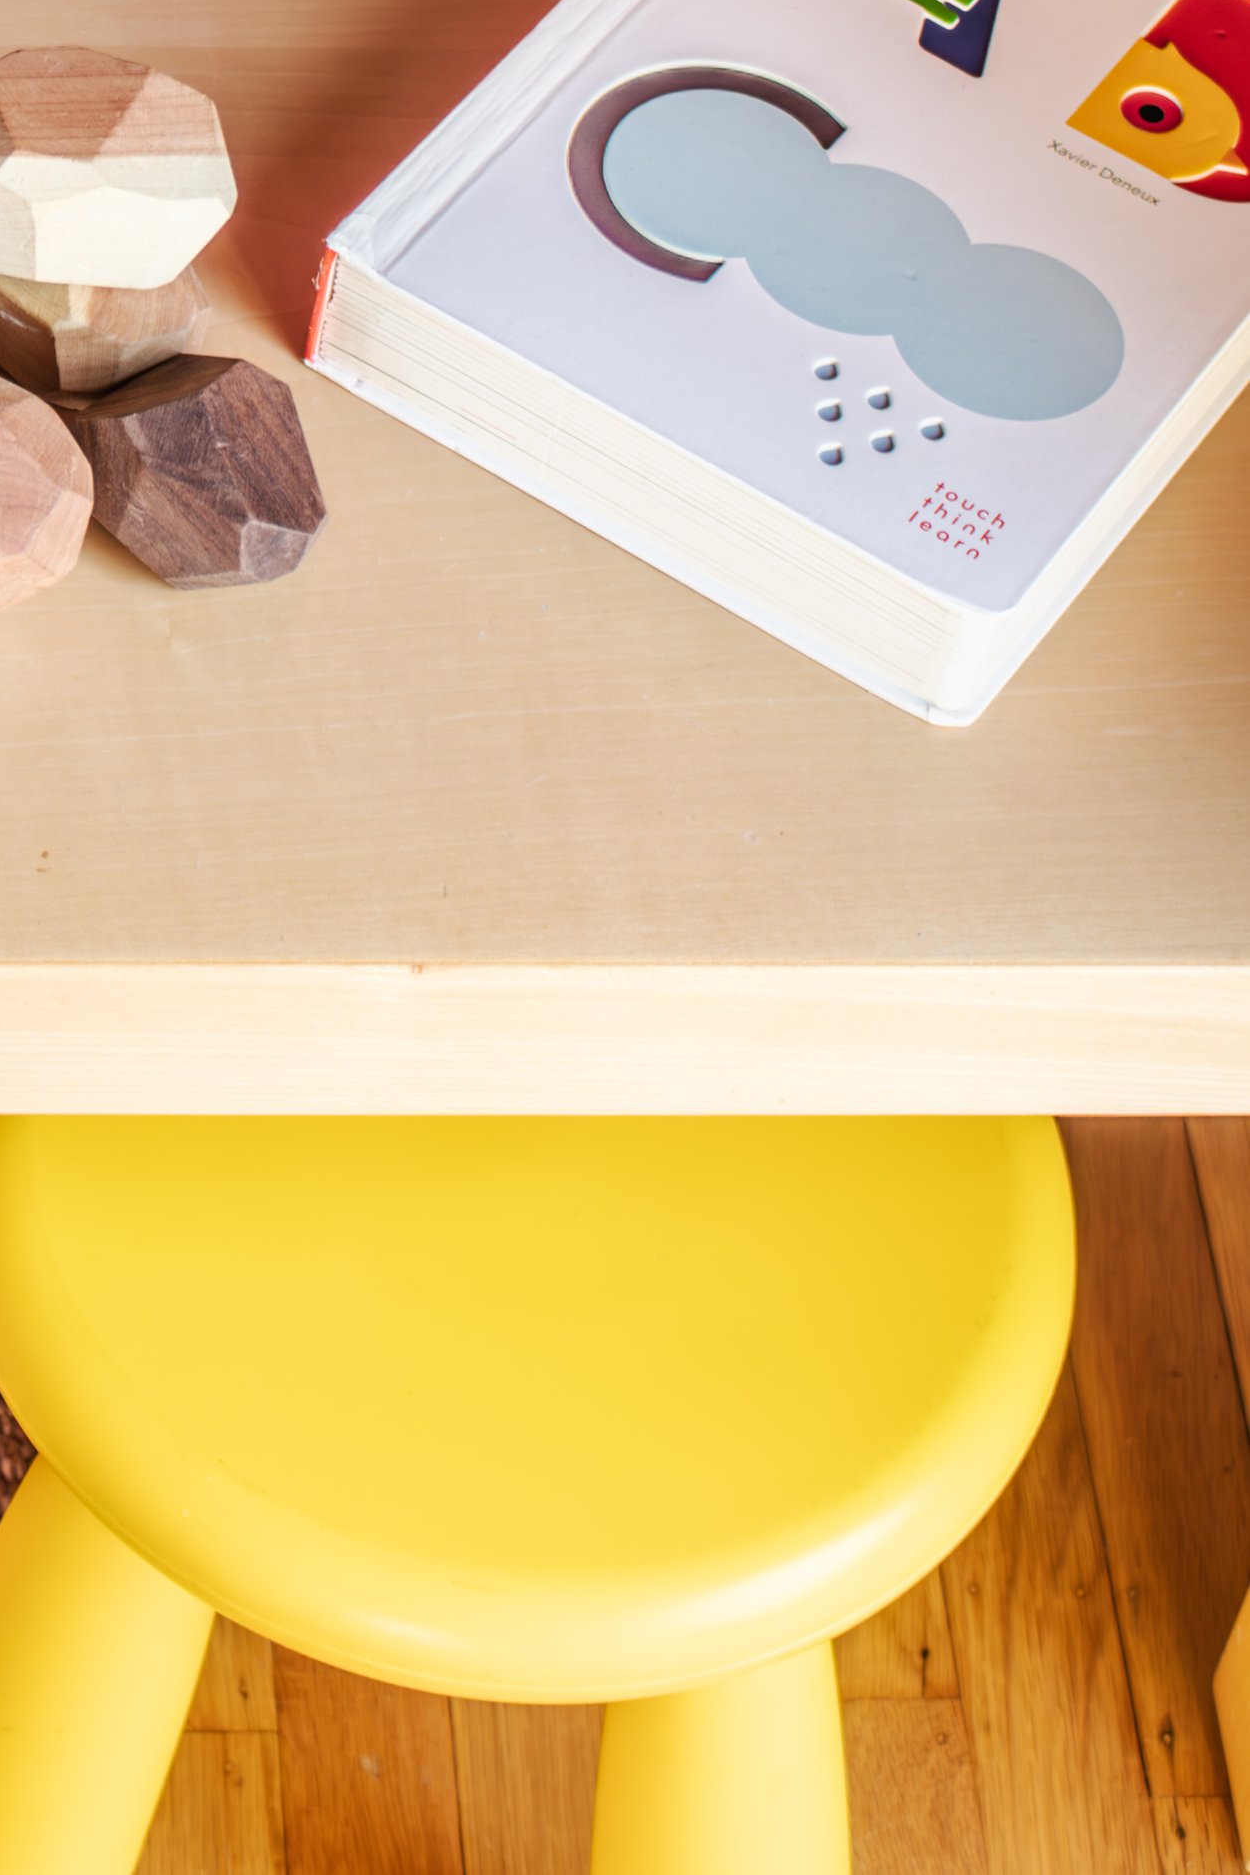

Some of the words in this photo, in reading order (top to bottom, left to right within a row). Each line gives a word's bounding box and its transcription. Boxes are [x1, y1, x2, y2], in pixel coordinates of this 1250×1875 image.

[1047, 139, 1097, 171] Xavier
[1098, 166, 1160, 206] Deneux
[922, 497, 994, 545] think
[935, 482, 1005, 530] touch
[909, 511, 980, 560] learn
